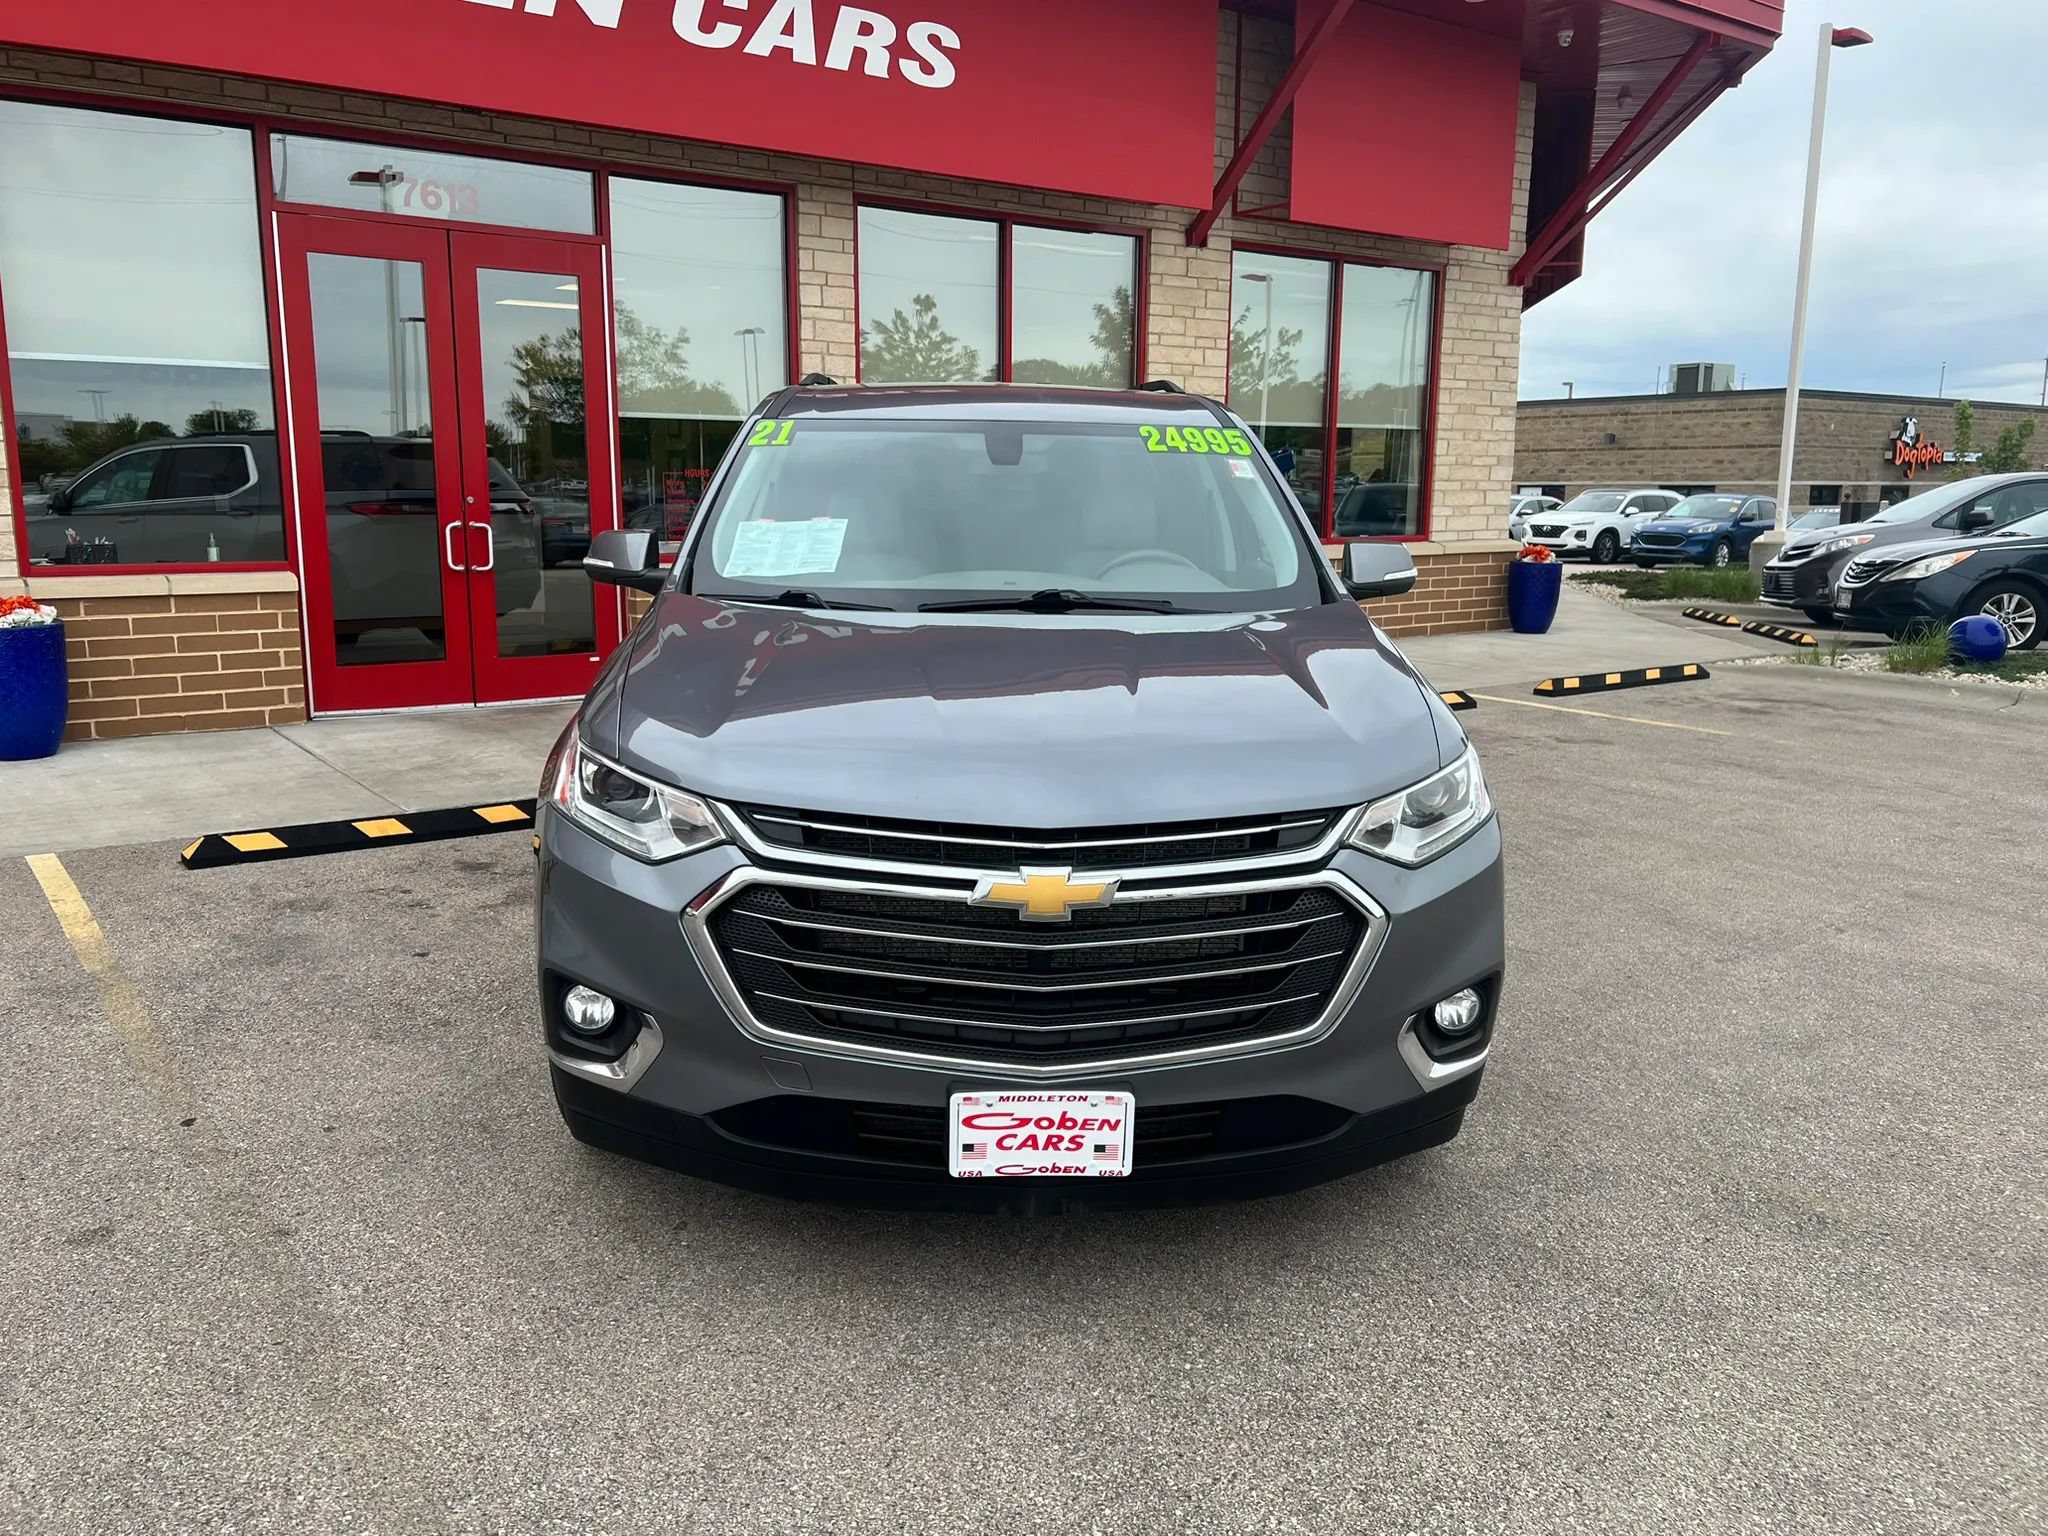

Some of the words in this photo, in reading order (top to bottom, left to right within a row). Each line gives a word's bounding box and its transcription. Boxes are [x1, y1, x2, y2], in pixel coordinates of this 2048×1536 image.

[671, 0, 962, 89] CARS
[402, 177, 479, 215] 7613
[747, 419, 796, 446] 21
[1138, 425, 1252, 456] 24995
[1894, 432, 1944, 480] Dogtopia
[684, 469, 710, 478] HOURS
[998, 1095, 1088, 1103] MIDDLETON
[995, 1133, 1087, 1152] CARS
[957, 1170, 983, 1178] USA
[1098, 1169, 1124, 1177] USA
